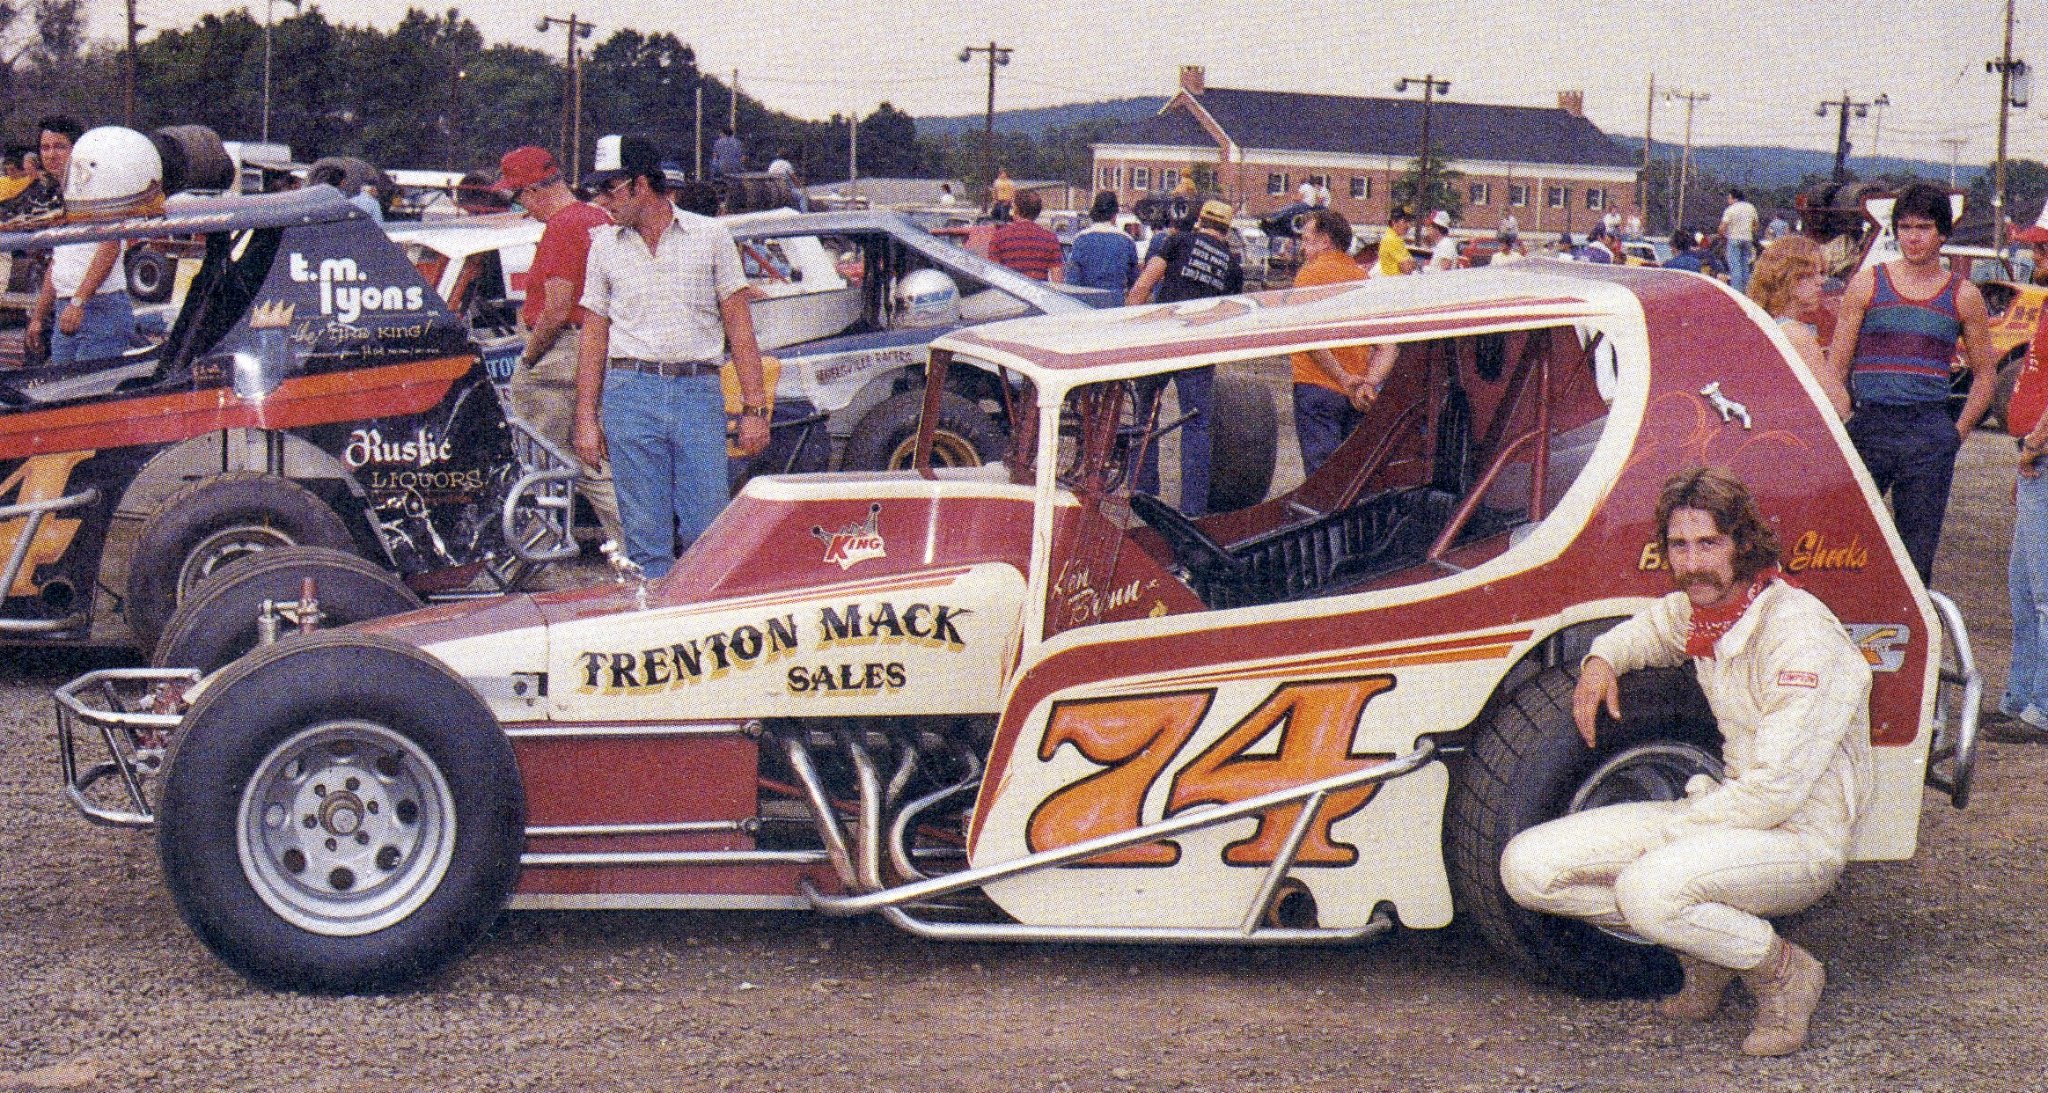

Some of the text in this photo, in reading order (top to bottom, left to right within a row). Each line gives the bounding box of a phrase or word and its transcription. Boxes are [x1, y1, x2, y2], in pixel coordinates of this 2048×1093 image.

[346, 428, 453, 467] Rustic
[371, 470, 484, 490] LIQUORS
[824, 533, 882, 561] KING
[576, 602, 974, 692] TRENTON MACK
[786, 661, 907, 694] SALES
[1025, 673, 1398, 868] 74
